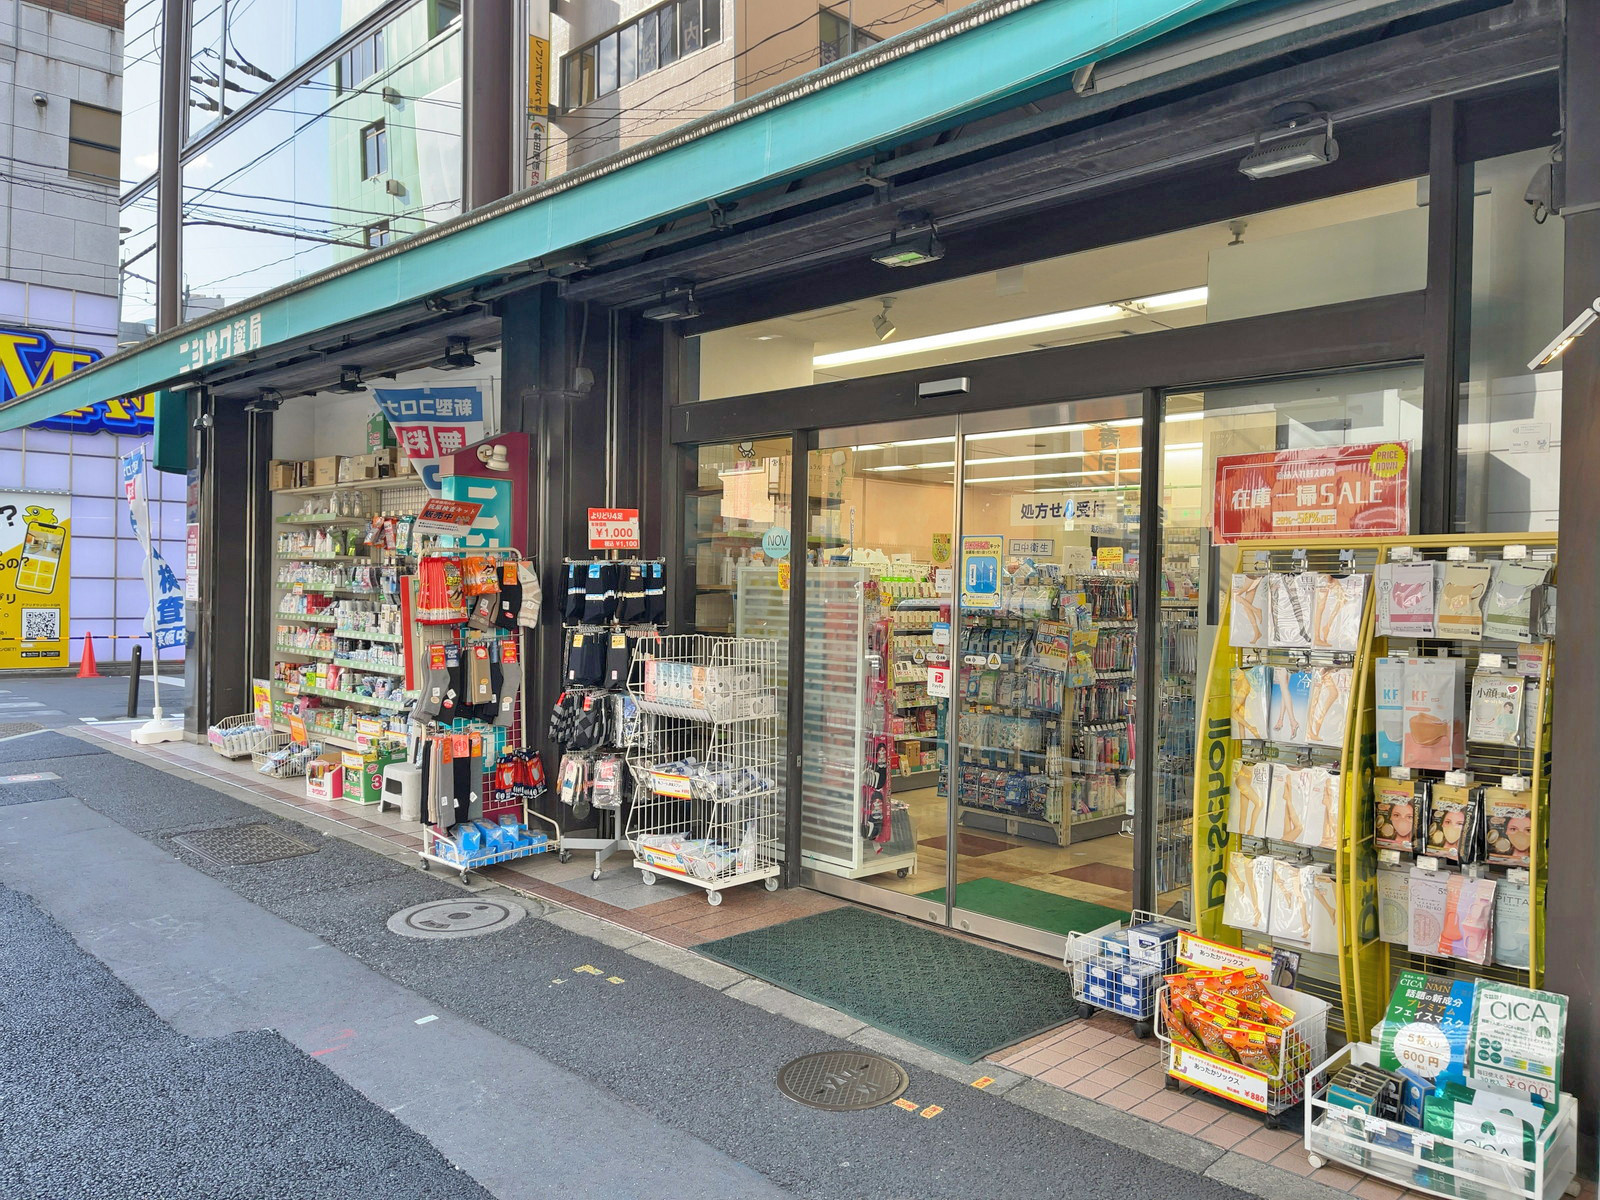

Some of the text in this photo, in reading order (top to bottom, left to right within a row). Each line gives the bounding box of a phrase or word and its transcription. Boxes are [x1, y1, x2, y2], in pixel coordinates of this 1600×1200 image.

[1377, 450, 1399, 460] PRICE
[1376, 462, 1399, 471] DOWN
[1231, 480, 1384, 510] 在庫一掃SALE
[591, 512, 623, 520] よりどり4足
[596, 528, 633, 538] ¥1,000
[767, 535, 789, 547] NOV
[1013, 542, 1049, 553] 口中衛生
[157, 564, 184, 625] 検査
[1297, 673, 1312, 689] 冷
[1383, 689, 1399, 700] KF
[1411, 690, 1428, 702] KF
[1495, 894, 1530, 906] PITTA
[1199, 949, 1245, 967] あったかソックス
[1400, 978, 1451, 994] CICA NMN
[1405, 988, 1464, 1008] 話題の新成分
[1406, 998, 1456, 1016] プレミアム
[1490, 1001, 1550, 1024] CICA
[1393, 1005, 1465, 1029] フェイスマスク
[1407, 1033, 1440, 1049] 5枚入り
[1194, 1062, 1240, 1086] あったかソックス
[1244, 1090, 1265, 1104] ¥880
[1505, 1078, 1549, 1100] ¥900
